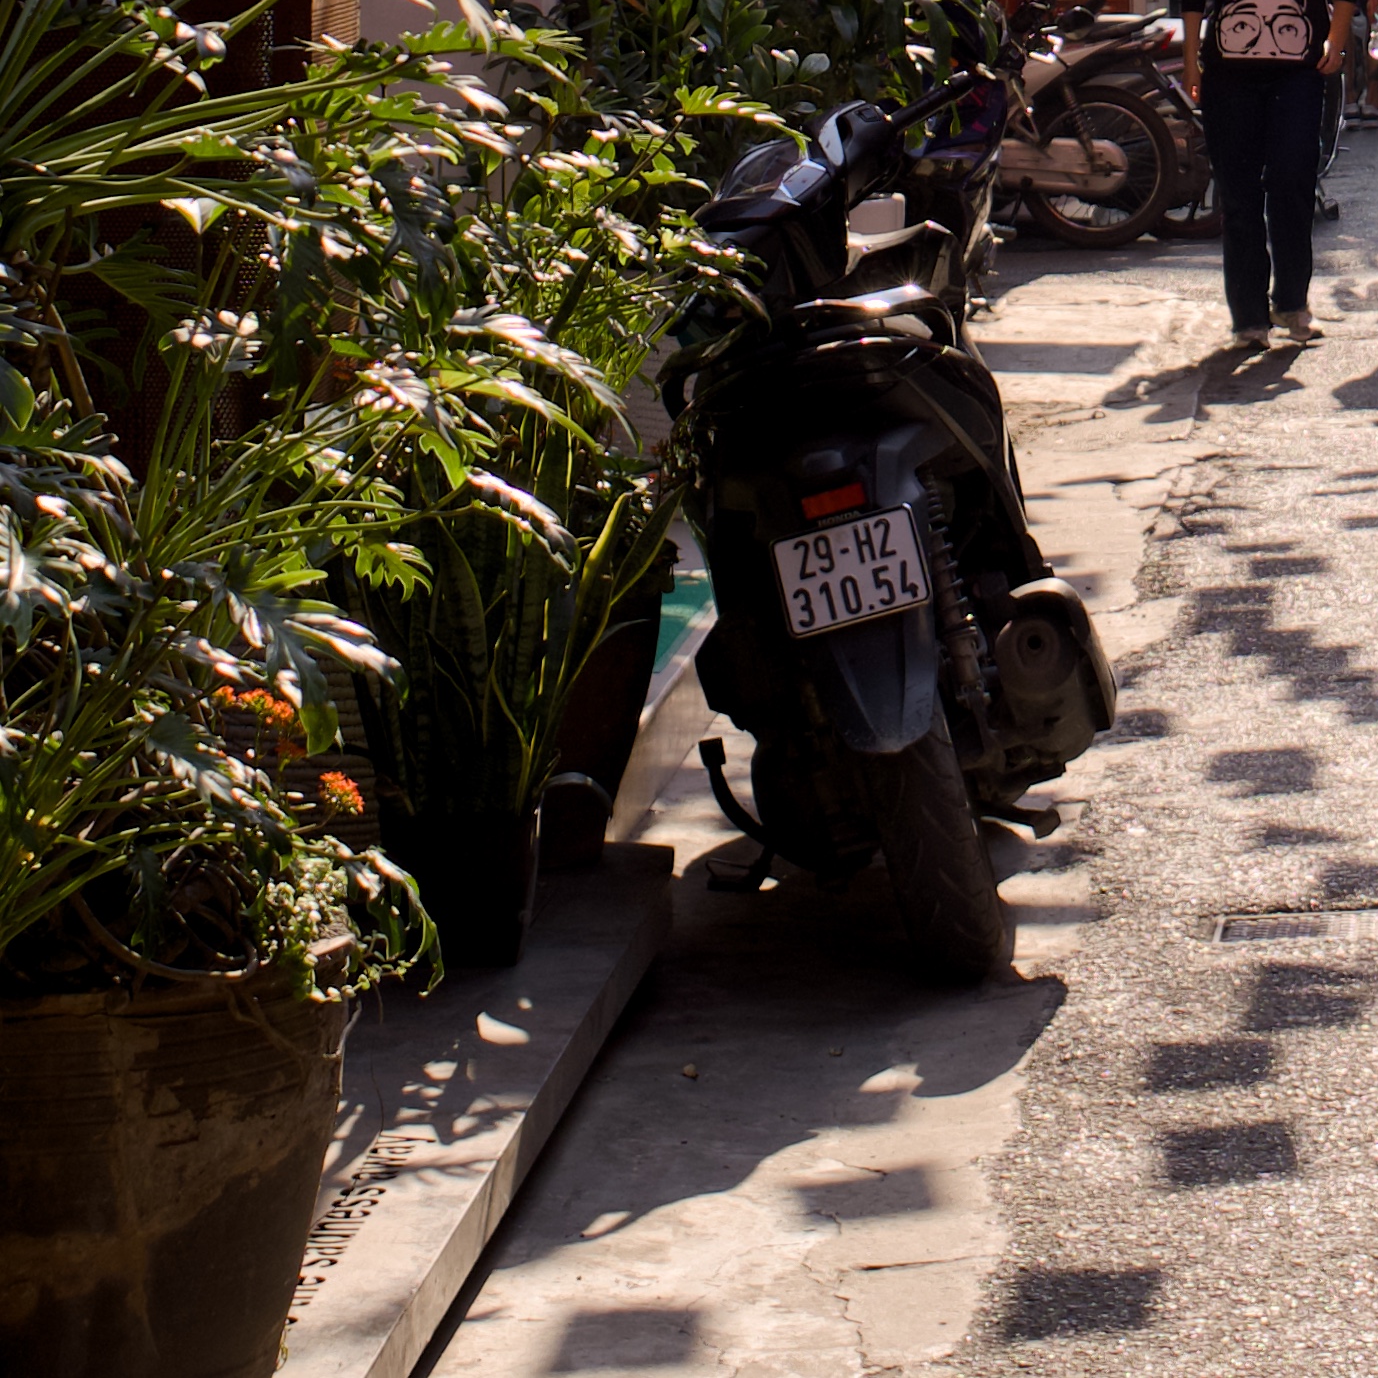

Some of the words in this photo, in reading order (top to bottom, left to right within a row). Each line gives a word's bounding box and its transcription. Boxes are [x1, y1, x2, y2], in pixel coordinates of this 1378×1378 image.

[793, 518, 897, 580] 29-H2
[818, 510, 862, 527] HONDA
[793, 560, 919, 627] 310.54
